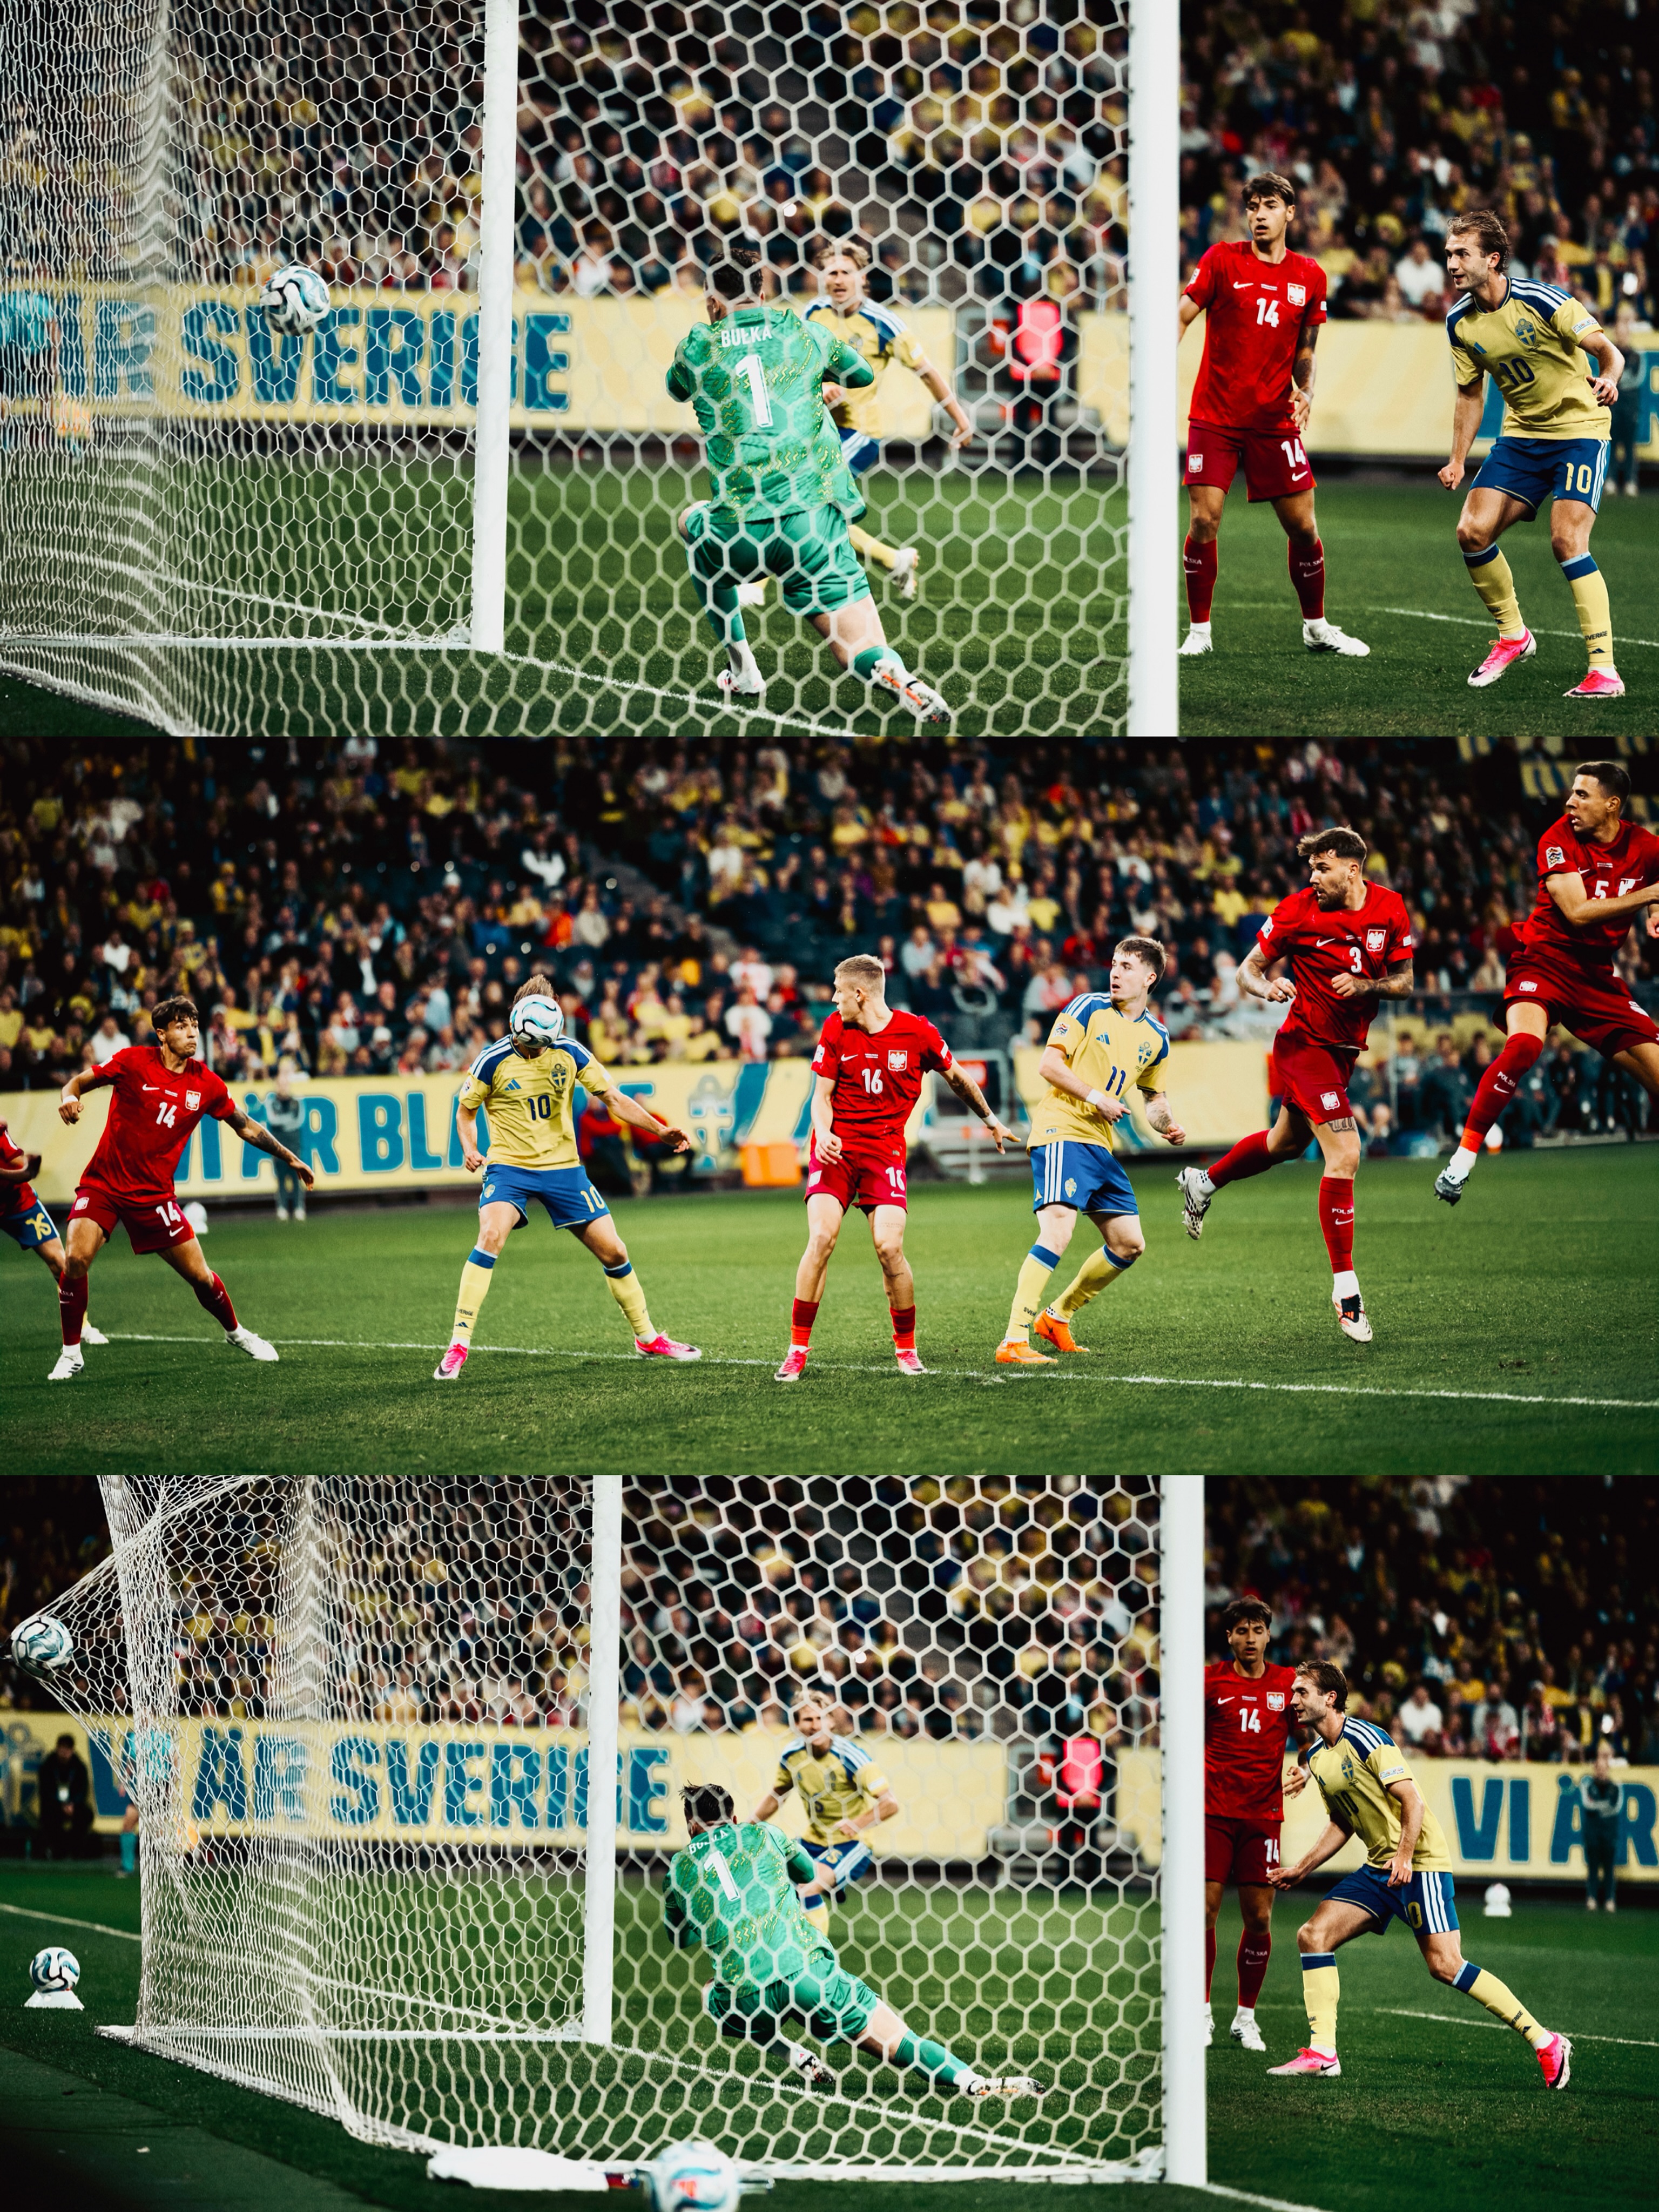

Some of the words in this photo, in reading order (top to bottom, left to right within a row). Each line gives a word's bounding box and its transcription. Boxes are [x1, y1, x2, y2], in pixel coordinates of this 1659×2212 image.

[1257, 298, 1279, 328] 14
[721, 326, 773, 348] BUŁKA
[1499, 358, 1535, 386] 10
[735, 354, 773, 428] 1
[1280, 437, 1307, 468] 14
[1565, 463, 1593, 494] 10
[1585, 630, 1608, 641] SVERIGE
[1591, 880, 1609, 900] 5
[1349, 946, 1362, 974] 3
[861, 1068, 884, 1095] 16
[1105, 1065, 1127, 1096] 11
[156, 1101, 178, 1129] 14
[527, 1094, 551, 1121] 10
[580, 1185, 605, 1213] 10
[155, 1201, 181, 1227] 14
[1239, 1708, 1262, 1734] 14
[1334, 1790, 1359, 1817] 10
[1451, 1776, 1530, 1863] VI
[1264, 1838, 1279, 1864] 14
[704, 1850, 741, 1902] 1
